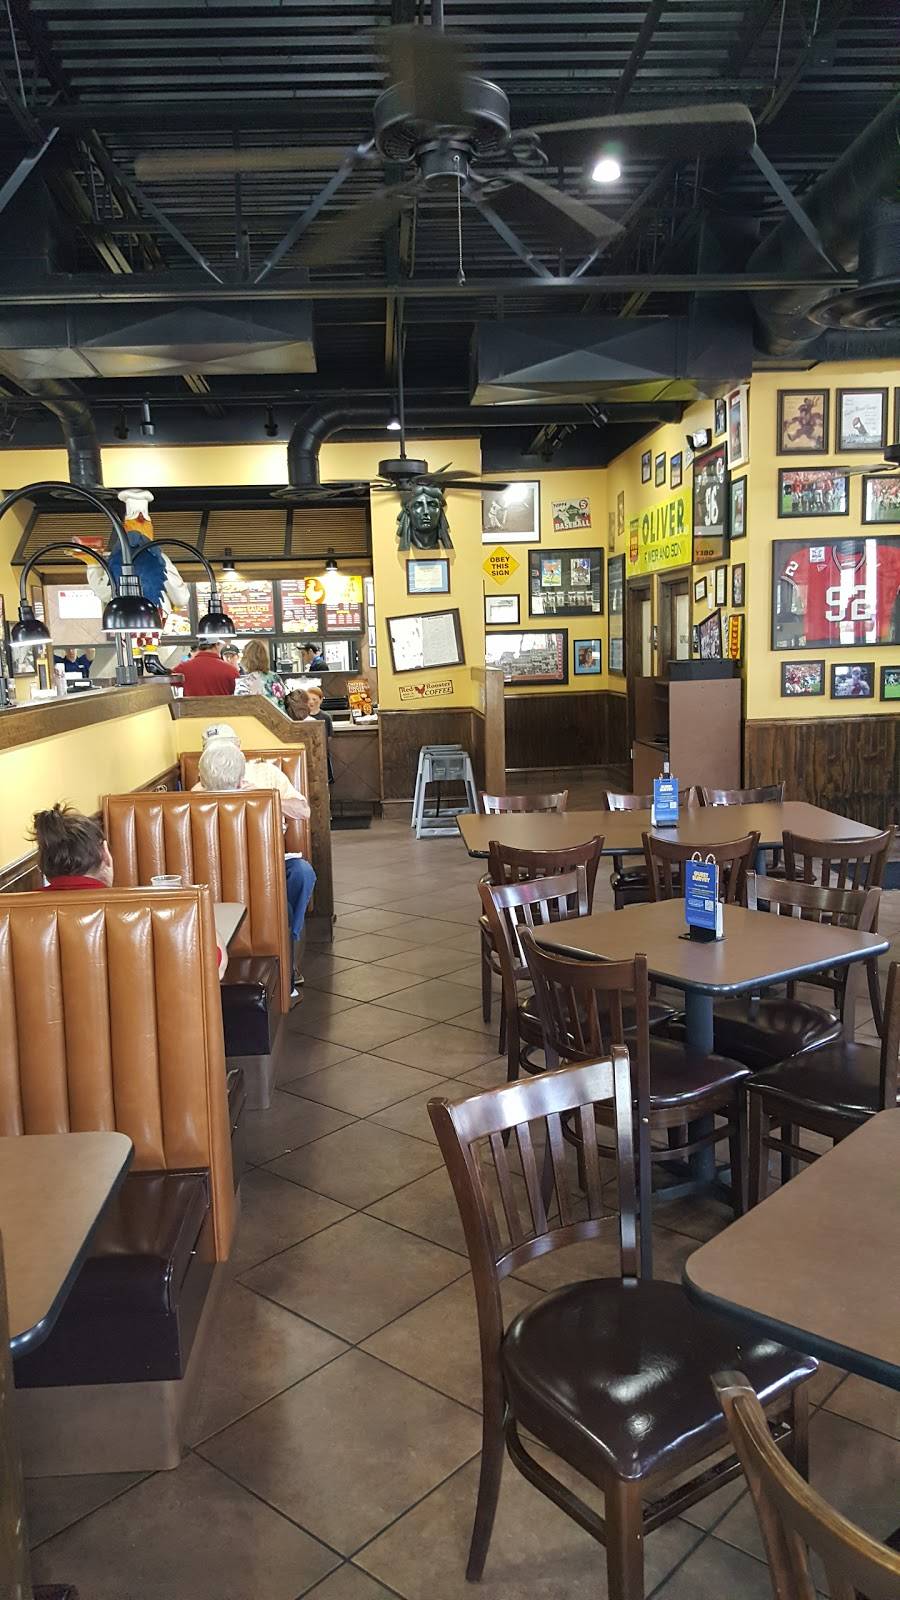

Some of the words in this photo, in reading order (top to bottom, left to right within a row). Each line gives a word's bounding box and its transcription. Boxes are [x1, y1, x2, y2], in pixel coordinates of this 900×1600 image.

[555, 519, 591, 530] BASEBALL
[642, 498, 685, 545] OLIVER
[825, 584, 874, 622] 92
[424, 687, 452, 696] COFFEE
[426, 682, 451, 690] Rooster
